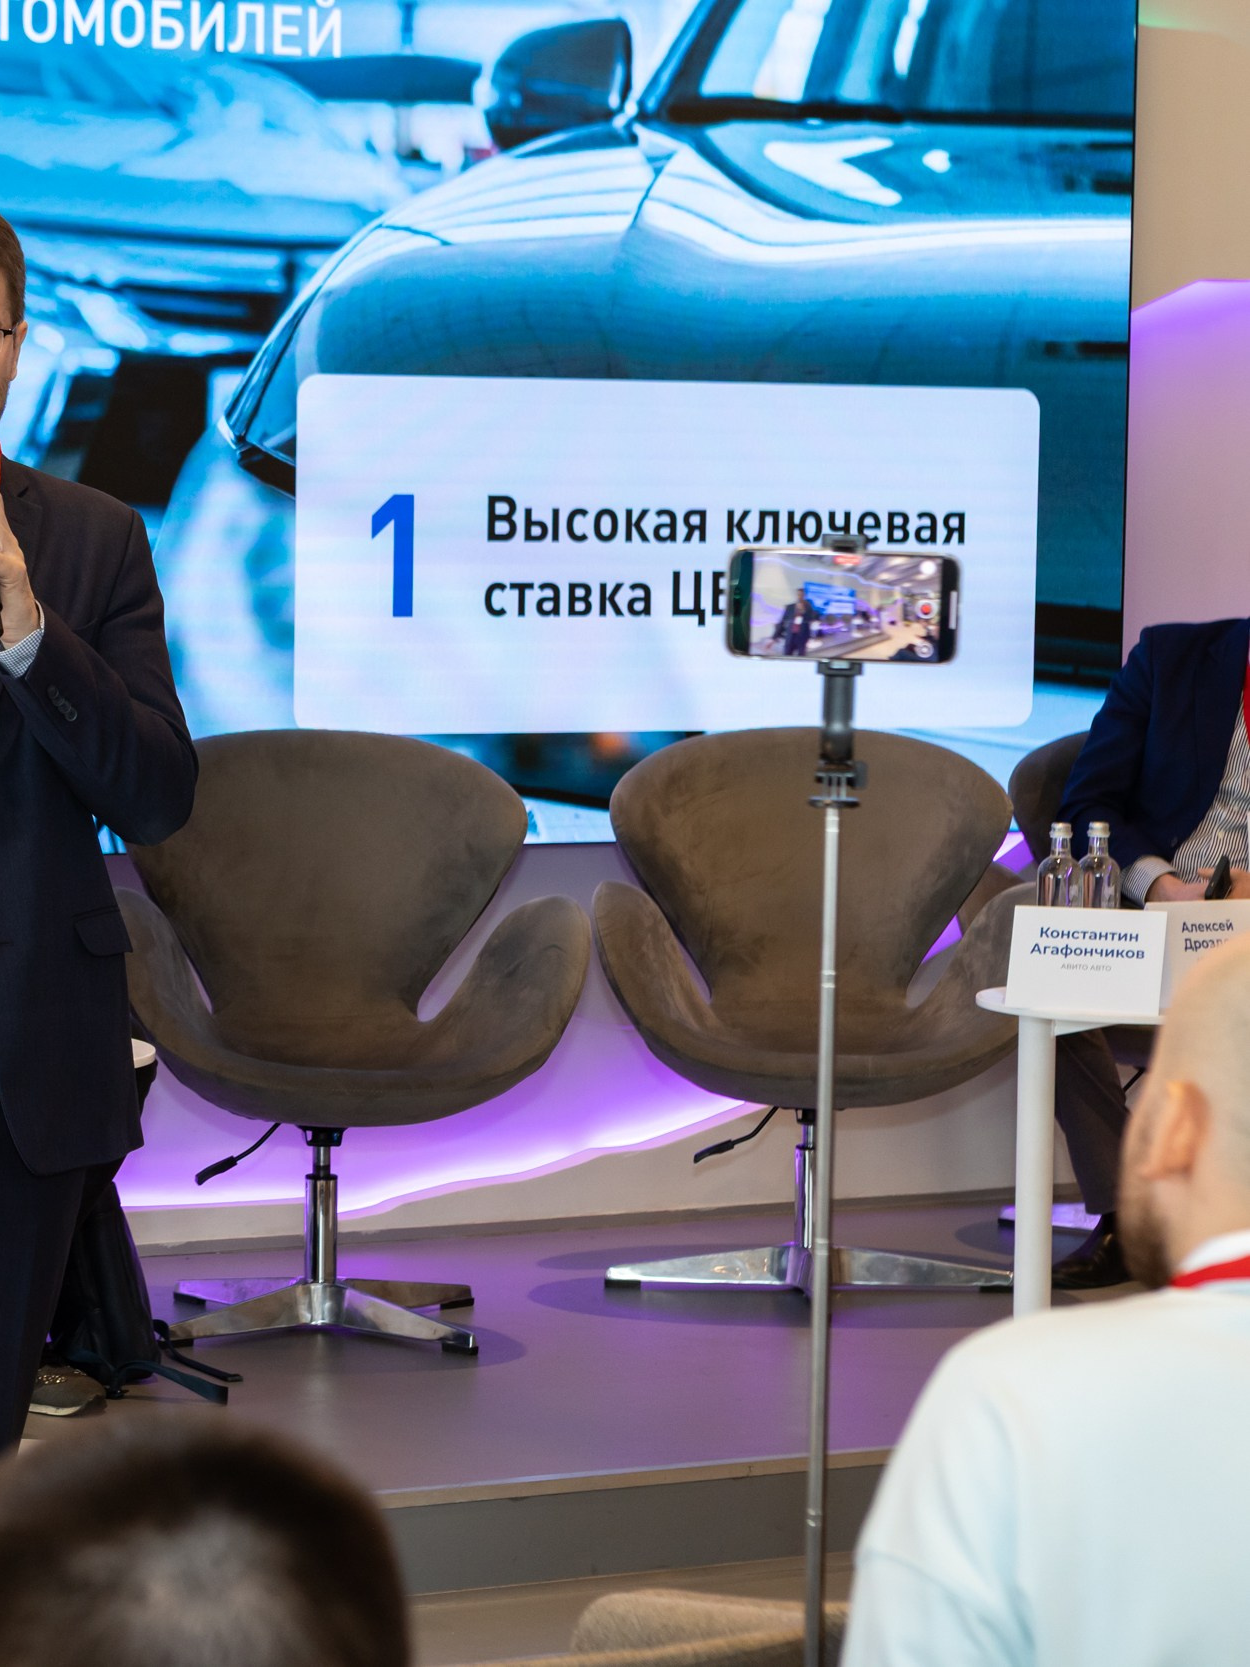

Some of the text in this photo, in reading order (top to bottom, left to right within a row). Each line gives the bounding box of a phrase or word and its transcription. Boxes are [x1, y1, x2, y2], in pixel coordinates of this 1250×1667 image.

[486, 494, 966, 545] Высокая ключевая
[371, 493, 415, 618] 1
[484, 578, 652, 618] ставка
[1039, 926, 1139, 942] Константин
[1181, 919, 1234, 933] Алексей
[1030, 943, 1145, 960] Агафончиков
